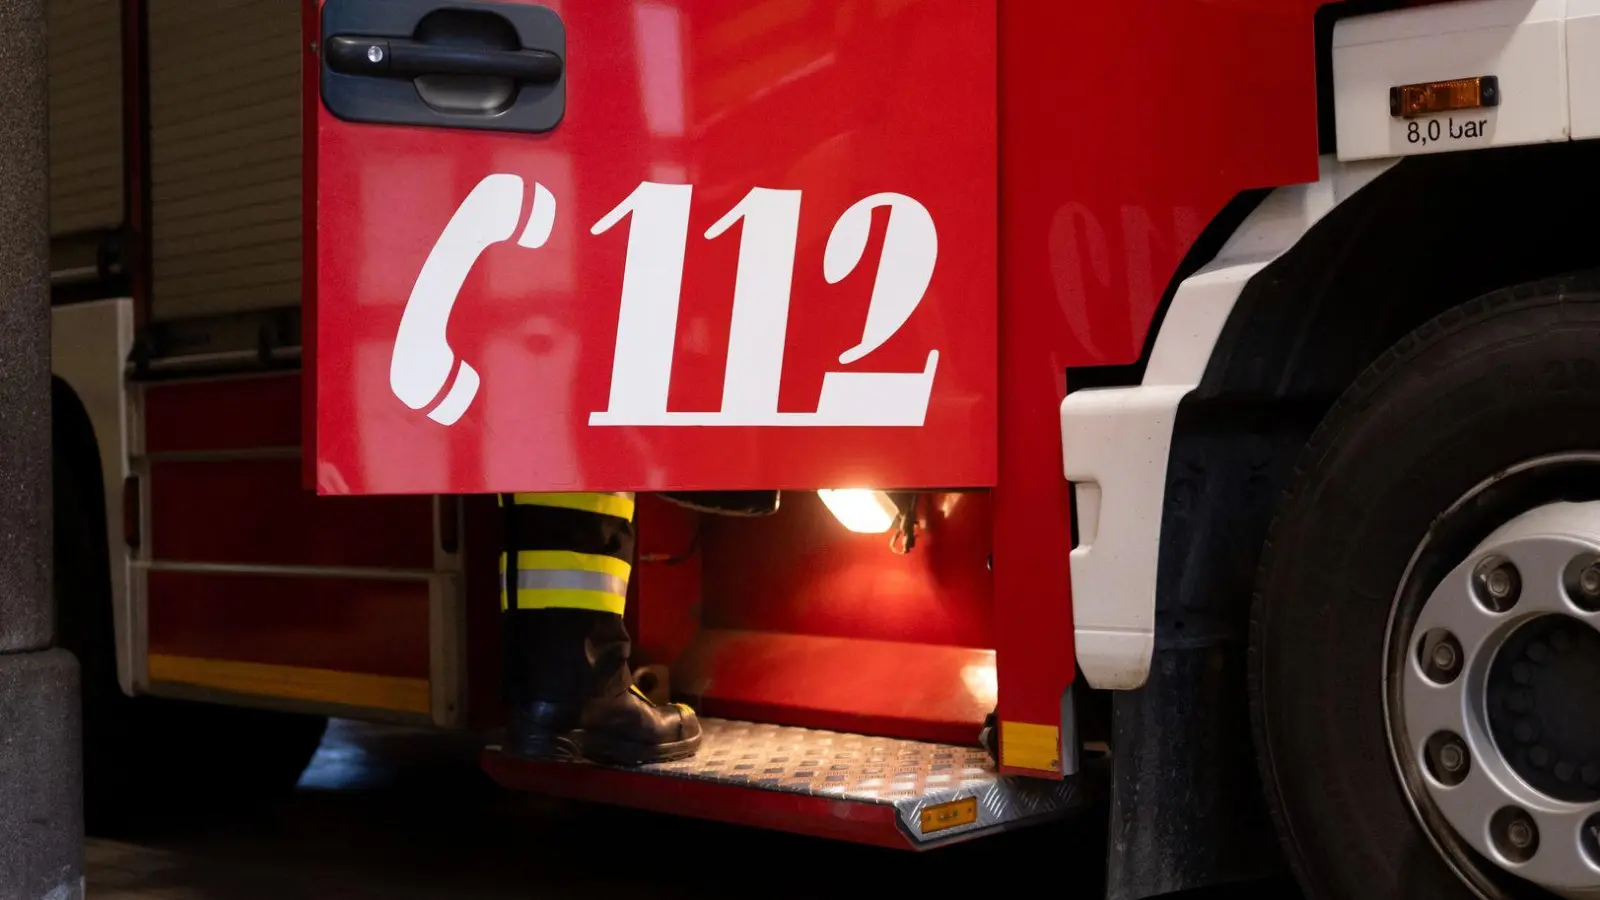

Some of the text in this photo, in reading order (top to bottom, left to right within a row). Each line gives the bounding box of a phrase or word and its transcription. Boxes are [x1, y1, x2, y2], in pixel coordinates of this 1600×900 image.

[1406, 117, 1488, 146] 8,0 bar
[588, 181, 939, 427] 112
